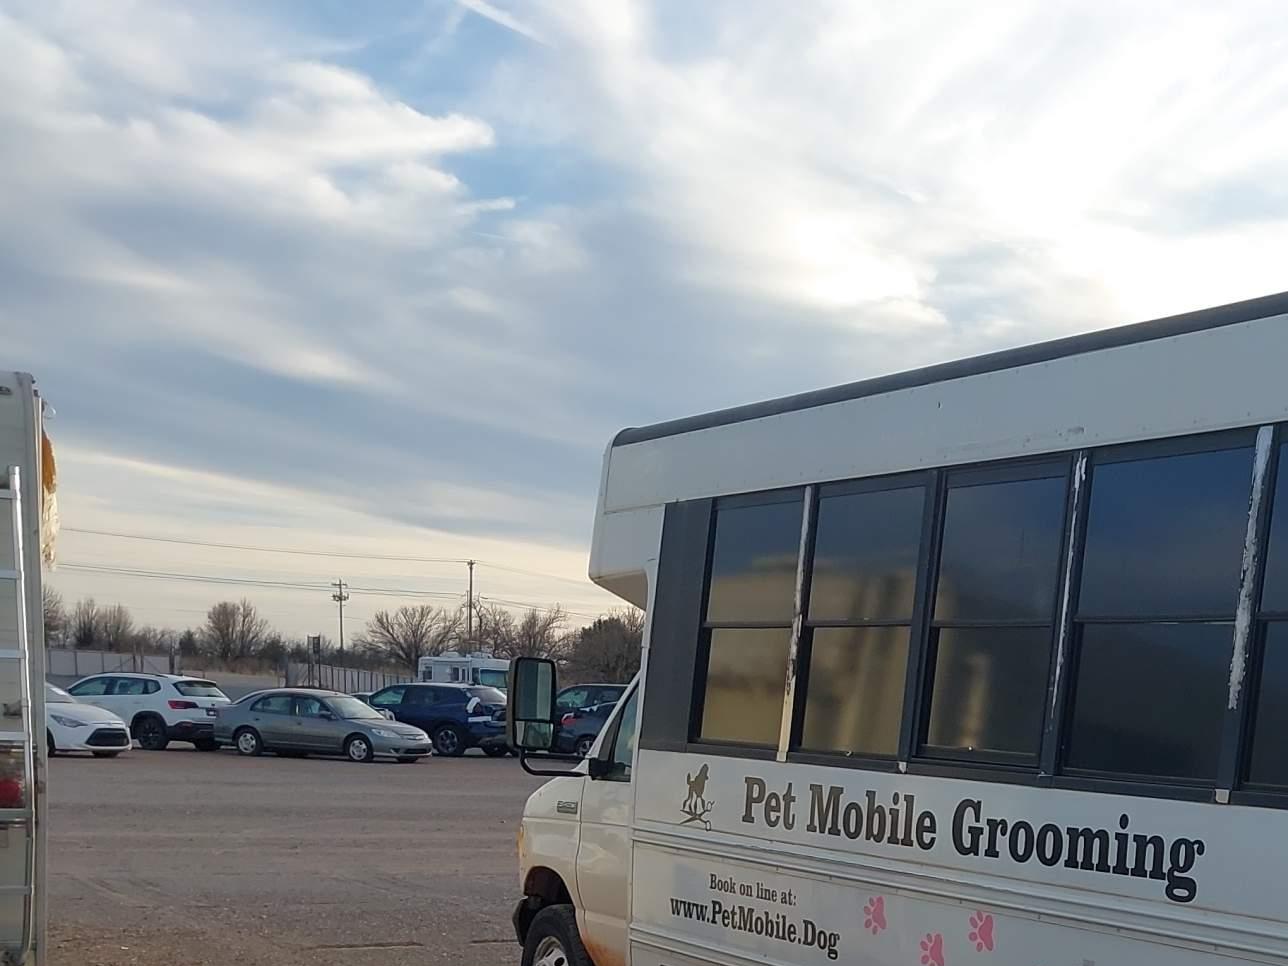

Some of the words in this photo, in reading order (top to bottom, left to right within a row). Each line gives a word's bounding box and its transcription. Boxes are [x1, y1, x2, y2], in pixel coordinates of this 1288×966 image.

[742, 776, 796, 831] Pet
[806, 783, 936, 851] Mobile
[952, 798, 1205, 903] Grooming
[709, 873, 737, 894] Book
[739, 881, 753, 897] on
[756, 882, 778, 903] line
[780, 888, 797, 906] at:
[670, 898, 840, 960] www.PetMobile.Dog
